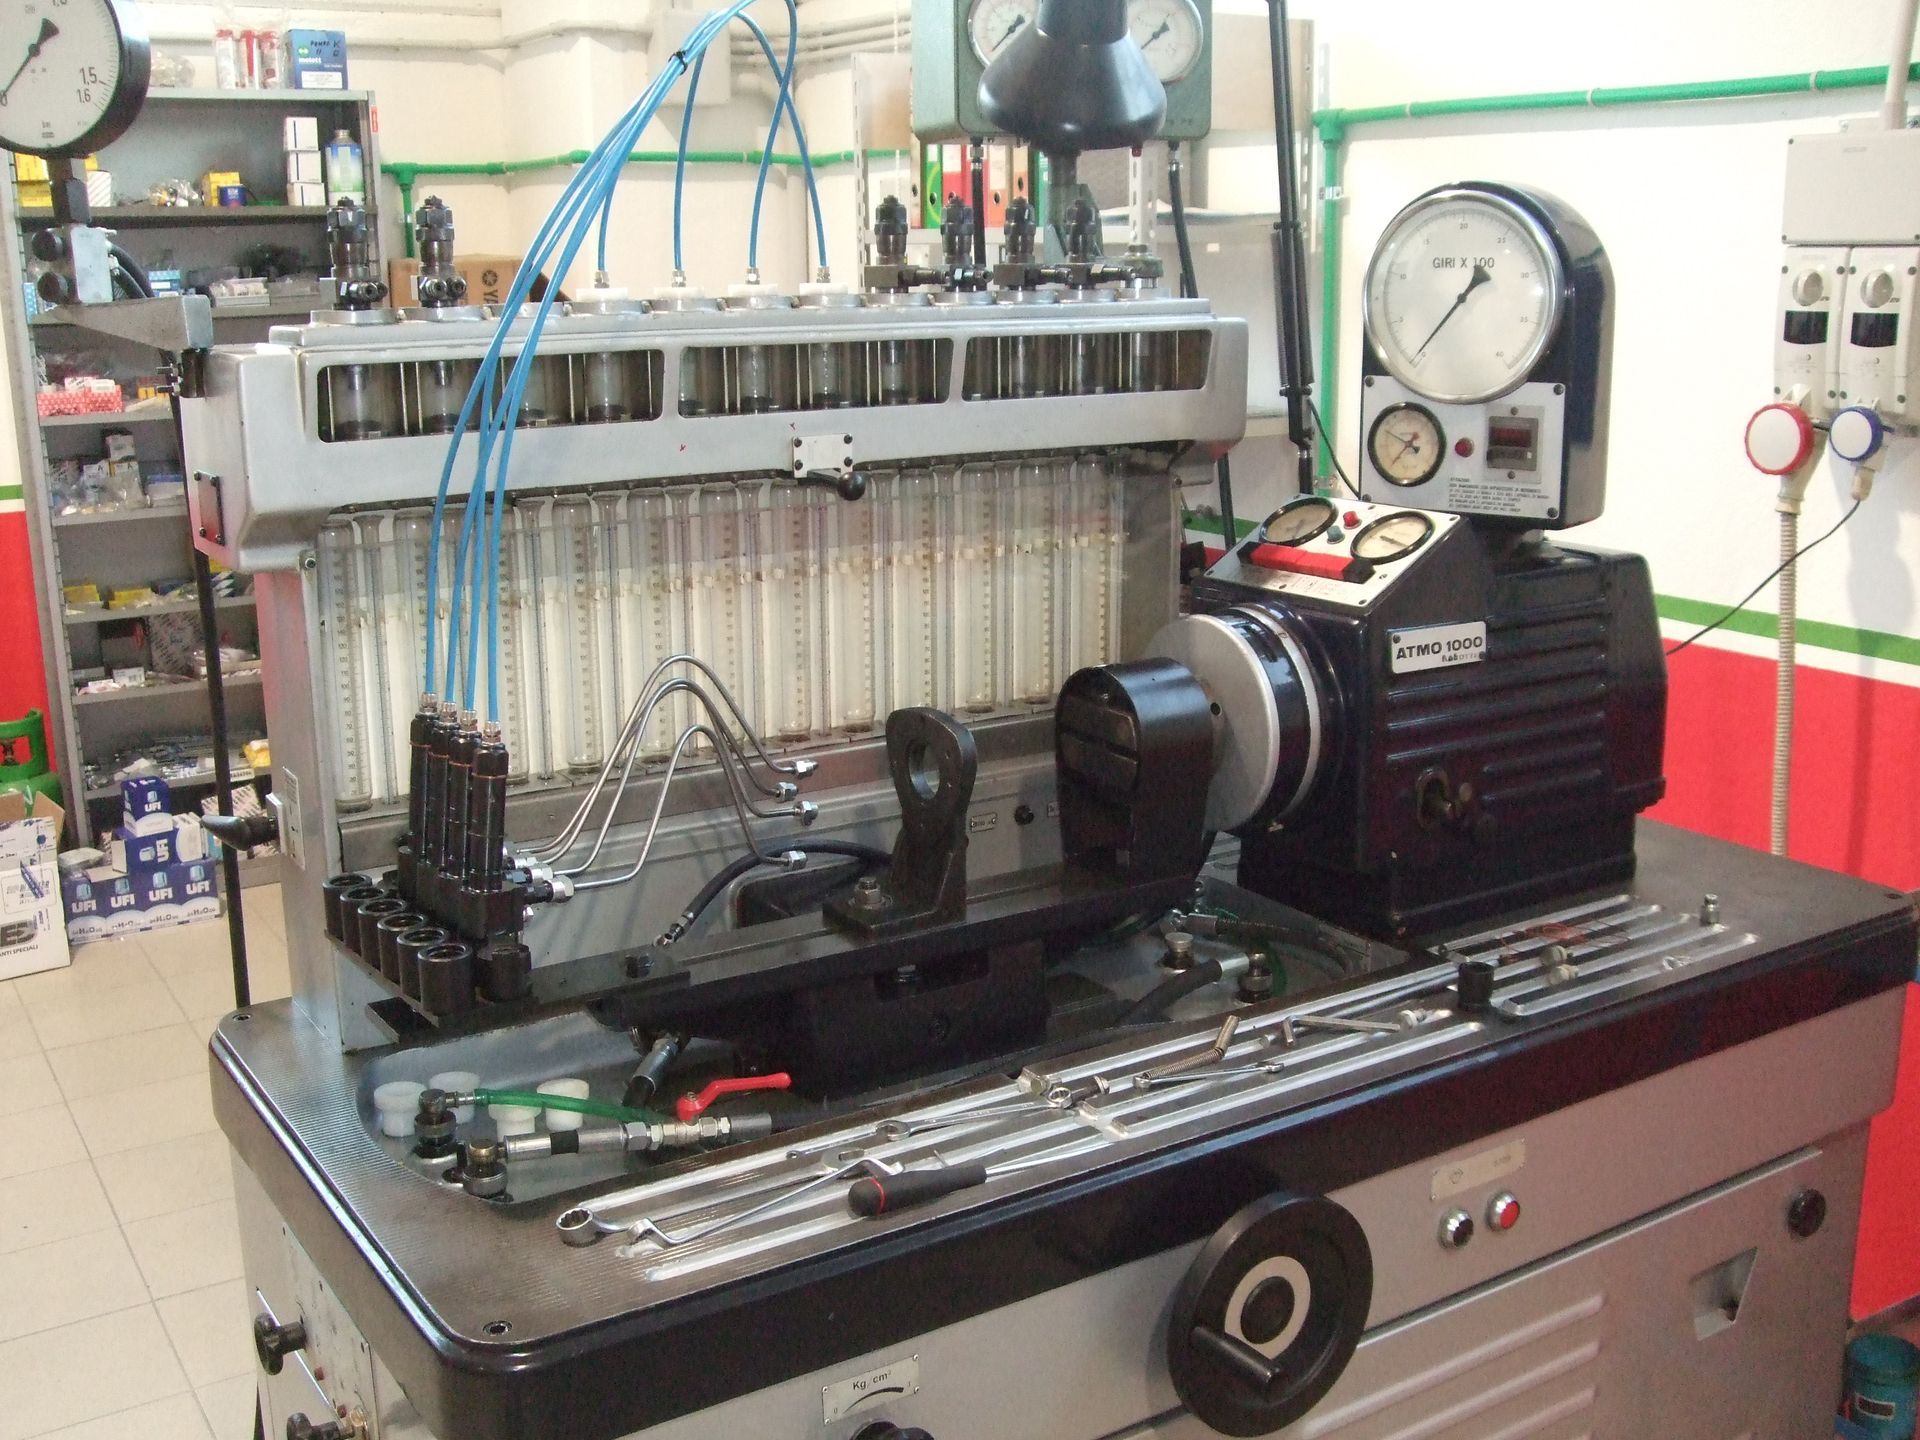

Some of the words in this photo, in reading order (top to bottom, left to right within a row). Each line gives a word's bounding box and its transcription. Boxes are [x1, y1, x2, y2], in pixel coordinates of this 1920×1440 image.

[1432, 257, 1456, 269] GIRI
[1460, 257, 1468, 268] X
[1473, 257, 1495, 269] 100
[1396, 641, 1443, 660] ATMO
[1446, 636, 1483, 652] 1000
[145, 801, 162, 812] UFI
[149, 887, 174, 902] UFI
[186, 880, 210, 895] UFI
[72, 899, 97, 913] UFI
[110, 893, 135, 908] UFI
